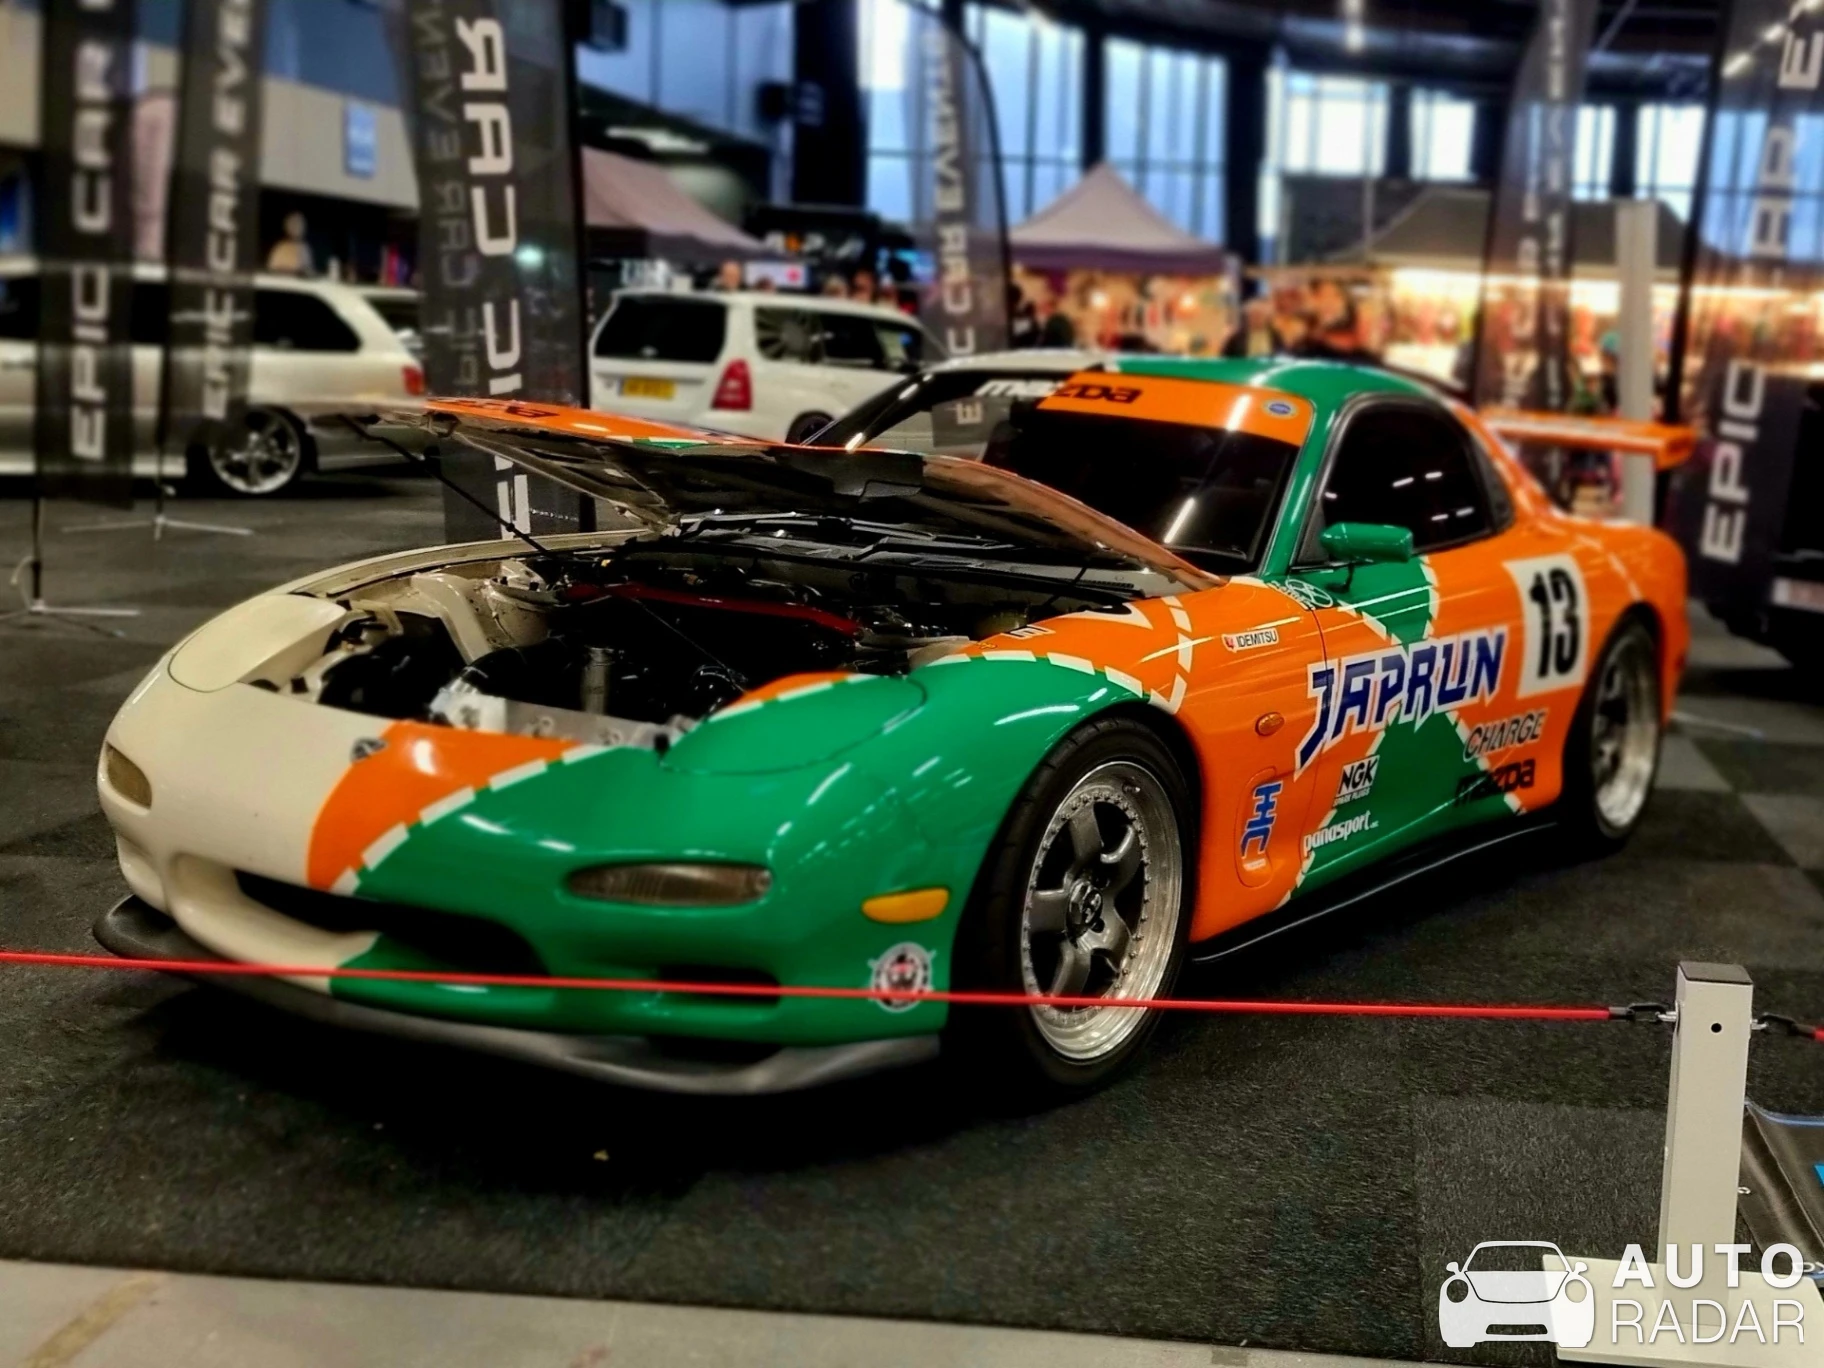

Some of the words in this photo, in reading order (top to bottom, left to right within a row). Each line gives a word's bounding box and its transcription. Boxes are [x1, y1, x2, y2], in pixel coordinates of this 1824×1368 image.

[71, 264, 109, 461] EPIC
[1701, 359, 1766, 564] EPIC
[1236, 630, 1277, 648] IDEMITSU
[1529, 568, 1580, 680] 13
[1296, 630, 1506, 774] JAPRUN
[1464, 709, 1549, 762] CHARGE
[1337, 757, 1378, 795] NGK
[1303, 810, 1371, 858] panasport
